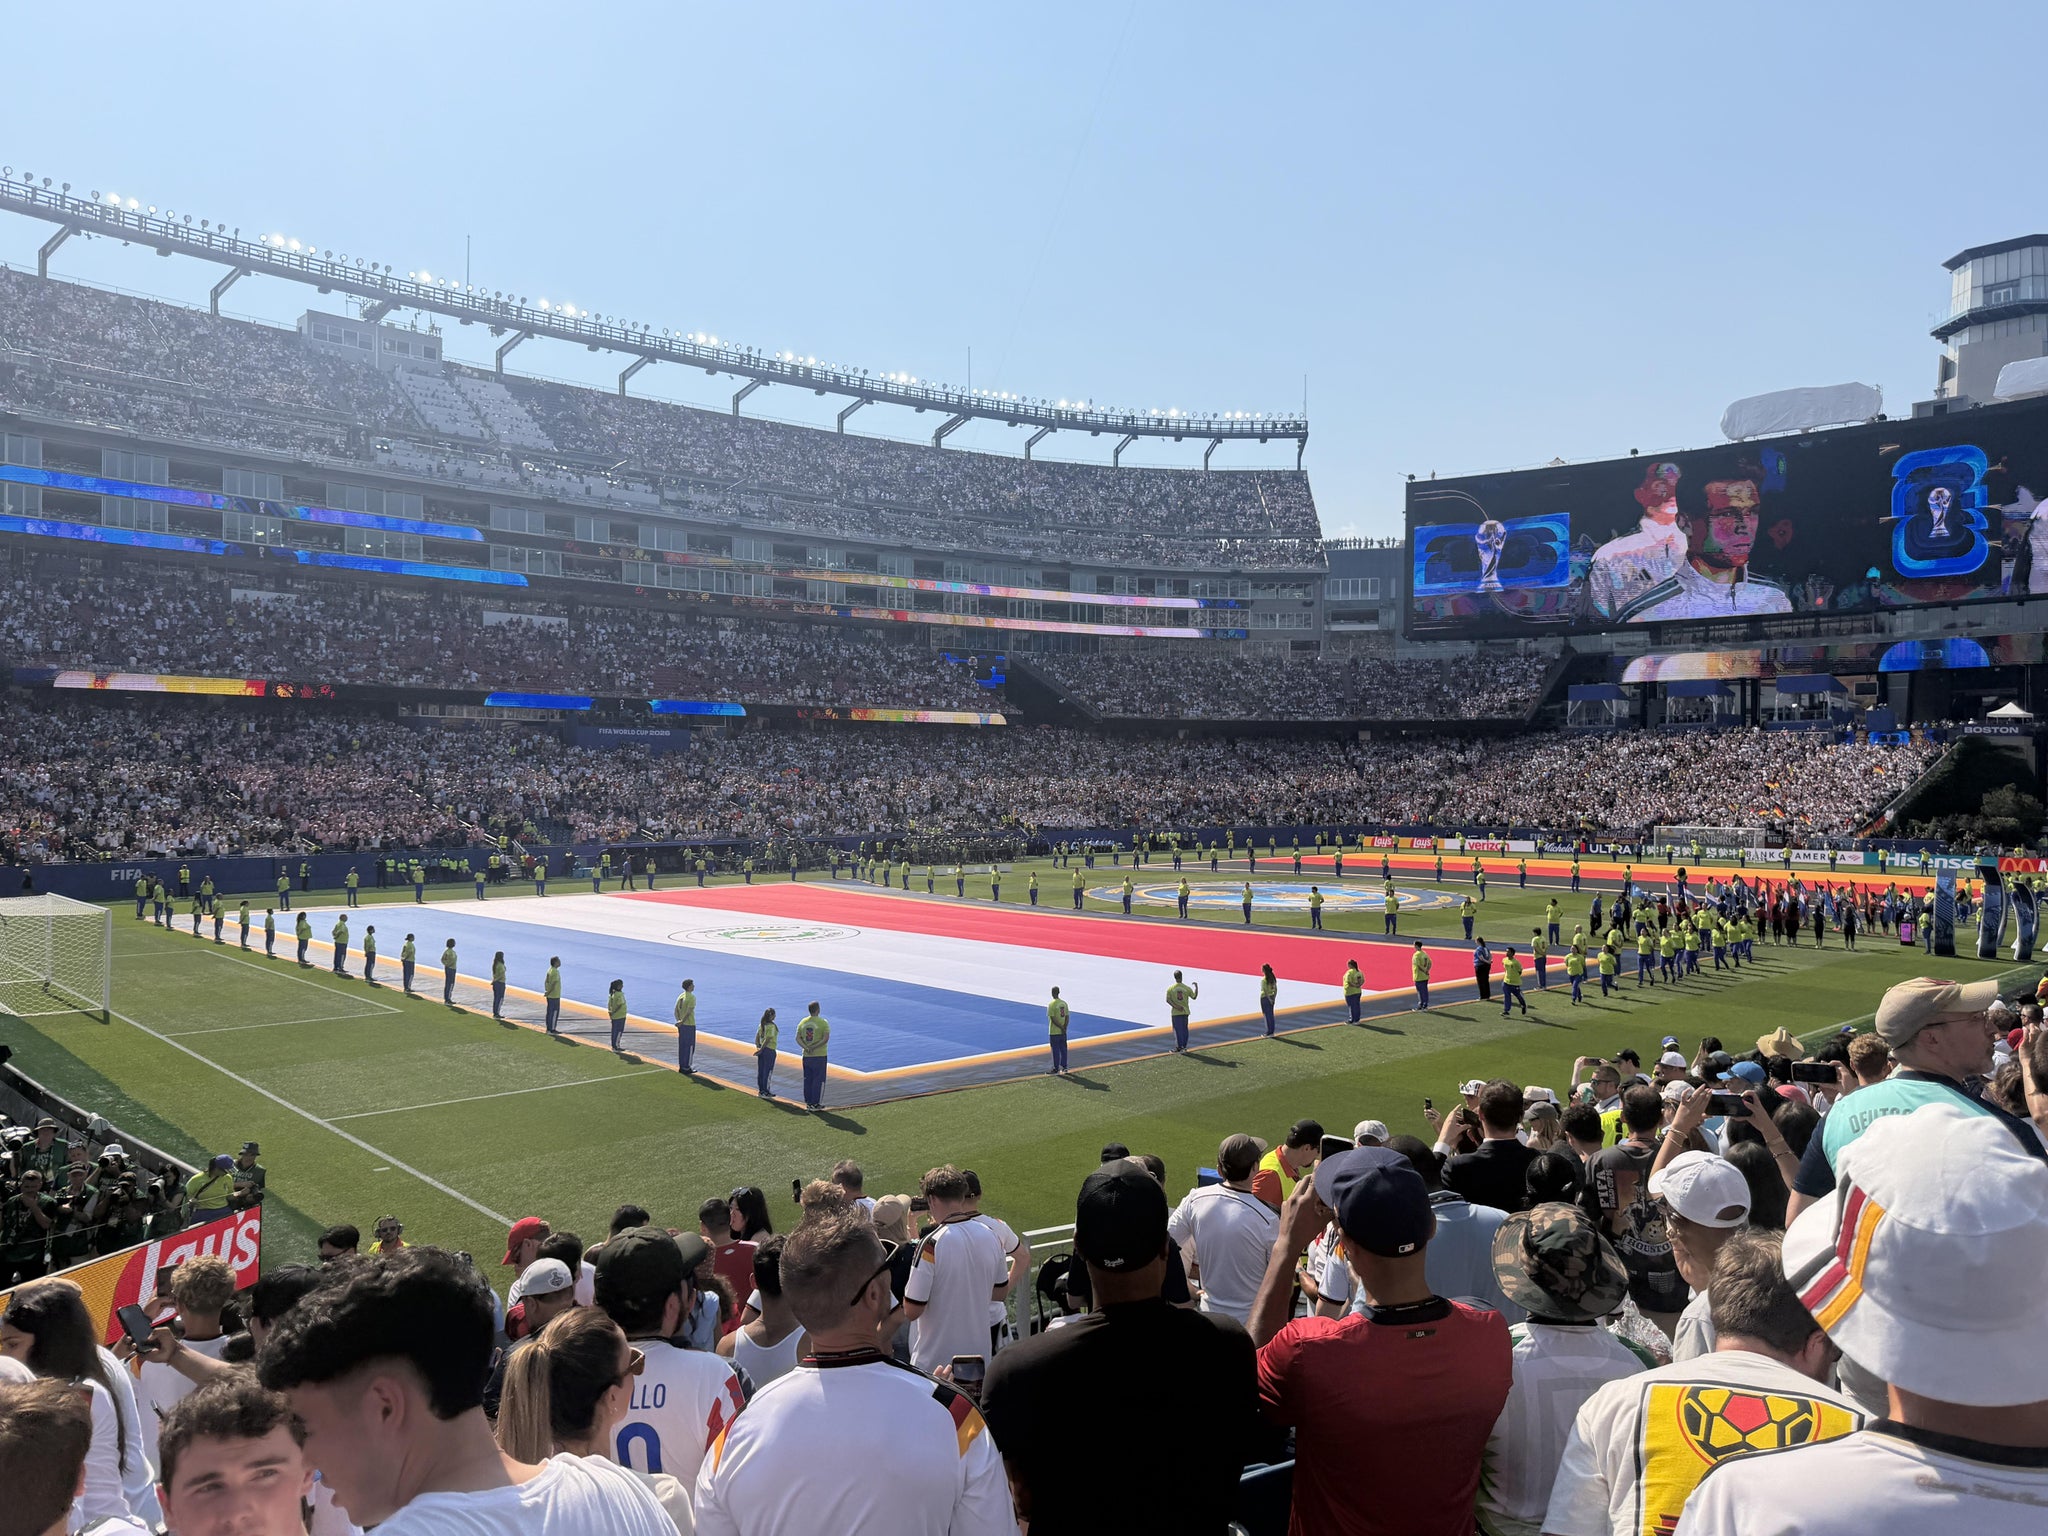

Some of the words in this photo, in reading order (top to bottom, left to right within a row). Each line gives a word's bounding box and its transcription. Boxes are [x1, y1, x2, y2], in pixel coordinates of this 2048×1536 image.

[1963, 726, 2019, 734] BOSTON
[1374, 836, 1392, 848] Lay's
[1413, 837, 1432, 849] Lay's
[1541, 841, 1575, 853] Michelo
[1589, 843, 1632, 855] ULTRA
[1746, 850, 1775, 859] BANK
[1795, 852, 1846, 862] AMERIA
[111, 868, 143, 881] FIFA
[1596, 1169, 1610, 1208] FIFA
[1626, 1237, 1671, 1254] HOUSTO
[1415, 1330, 1426, 1338] USA
[629, 1383, 667, 1410] LLO
